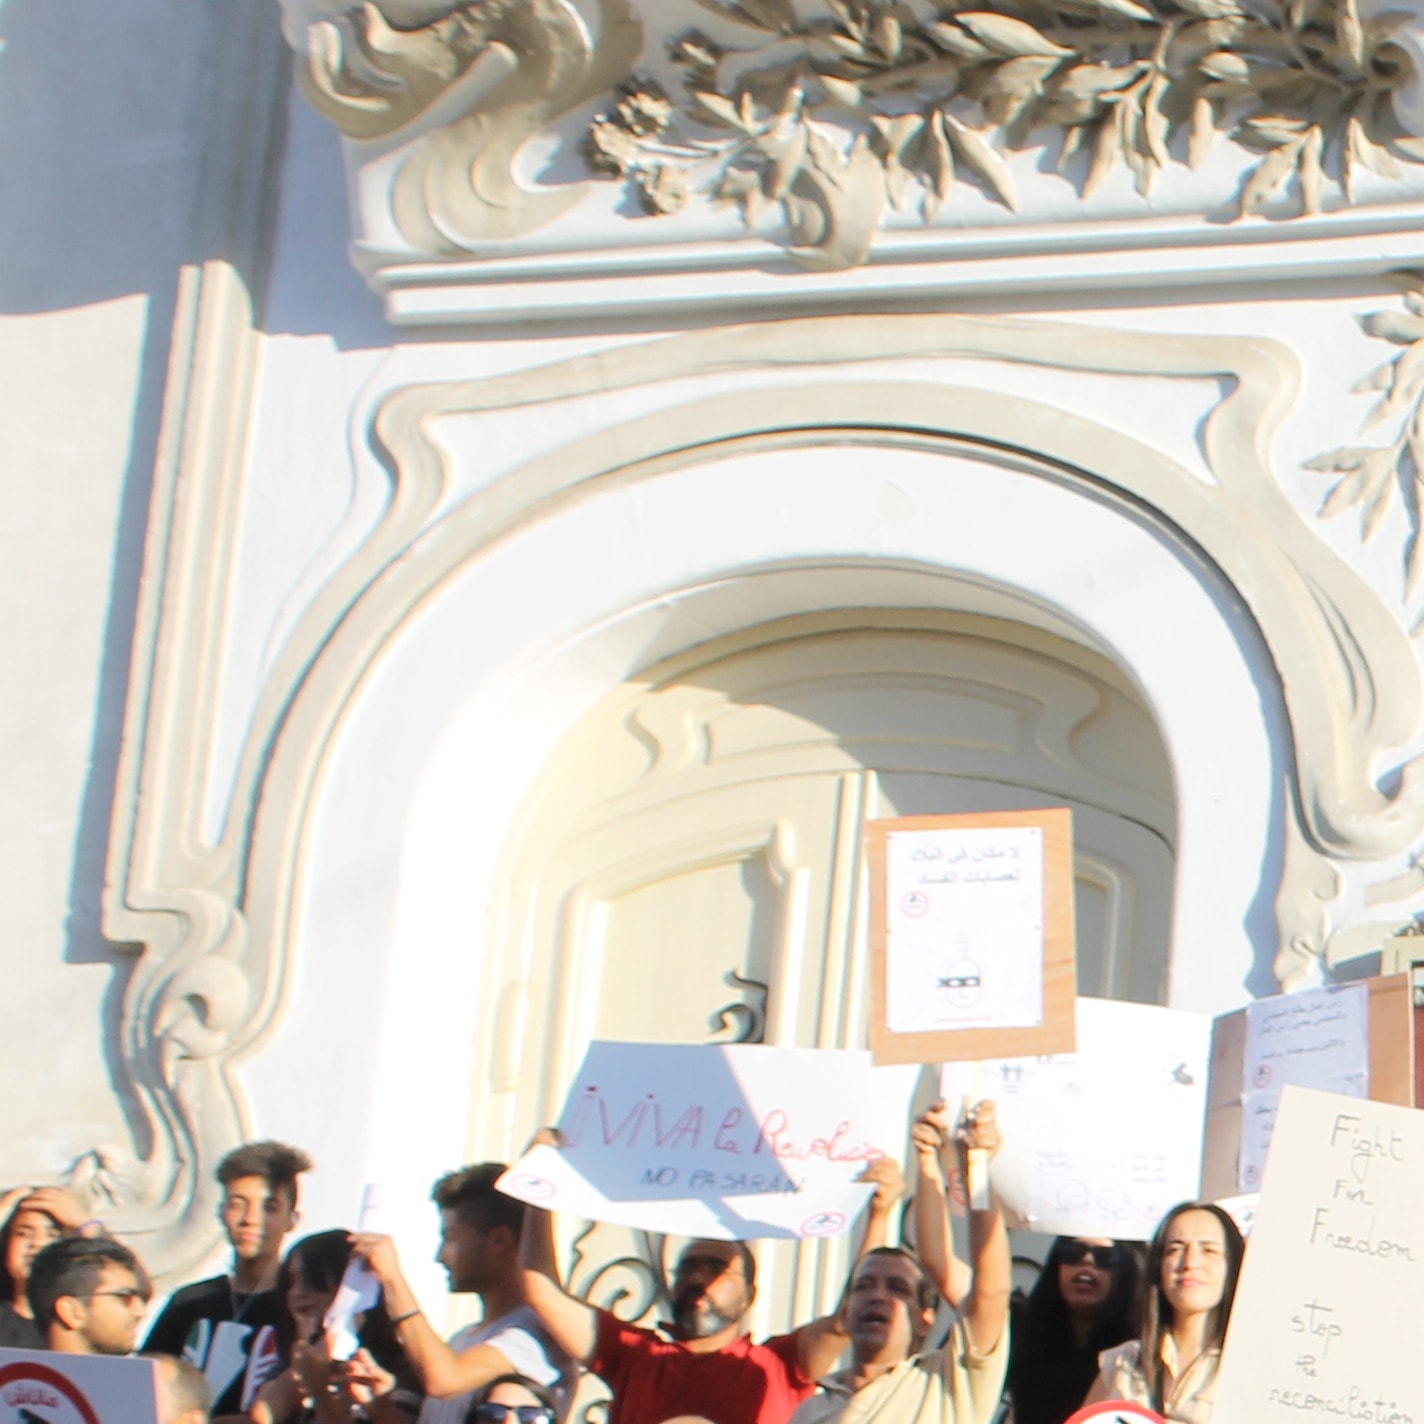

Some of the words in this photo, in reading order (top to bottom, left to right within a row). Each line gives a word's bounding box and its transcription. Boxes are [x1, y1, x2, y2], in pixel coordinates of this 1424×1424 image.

[640, 1166, 680, 1188] NO
[1330, 1114, 1404, 1184] Fight
[1309, 1207, 1416, 1263] Freedom
